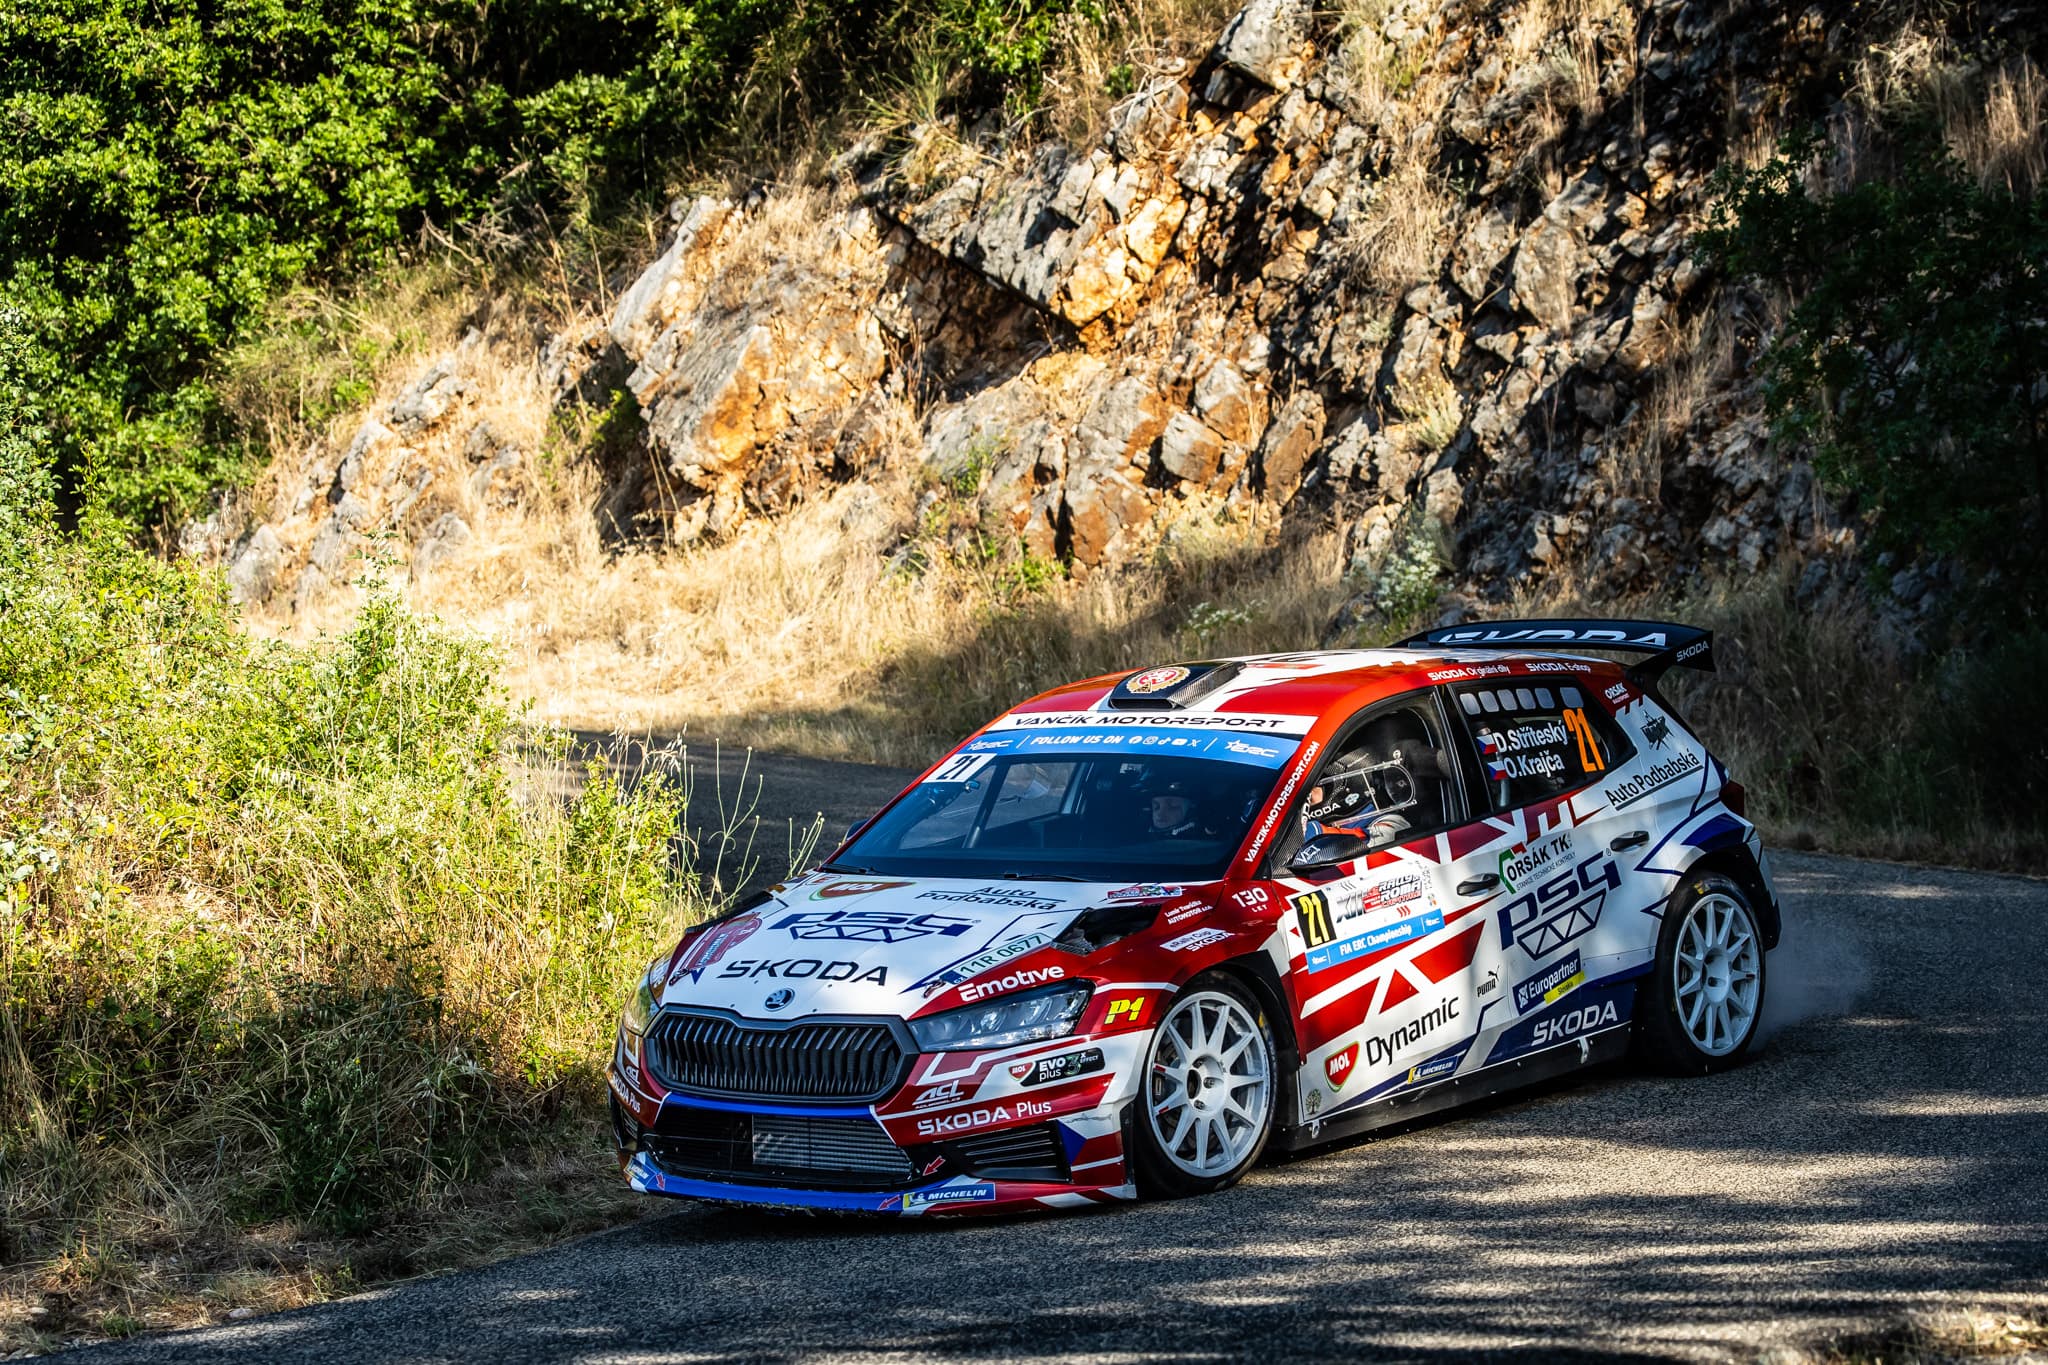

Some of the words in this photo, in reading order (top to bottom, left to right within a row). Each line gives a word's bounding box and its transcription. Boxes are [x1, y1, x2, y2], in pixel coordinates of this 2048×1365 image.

[1676, 640, 1710, 663] SKODA
[1015, 714, 1094, 726] VANČÍK
[1096, 716, 1286, 728] MOTORSPORT
[1030, 735, 1081, 745] FOLLOW
[1082, 735, 1103, 744] US
[1103, 735, 1124, 744] ON
[1563, 707, 1606, 773] 21
[935, 755, 982, 780] 21
[1503, 749, 1566, 779] O.Krajča
[1604, 777, 1638, 806] Auto
[1636, 748, 1700, 793] Podbabská
[1244, 740, 1321, 864] VANCIK-MOTORSPORT.COM
[1507, 844, 1551, 882] ORSÁK
[972, 886, 1038, 897] Auto
[1231, 887, 1270, 908] 130
[1252, 904, 1269, 913] LET
[1298, 894, 1331, 947] 21
[959, 956, 999, 974] 11R
[999, 934, 1043, 960] 0677
[1339, 943, 1353, 956] FIA
[716, 959, 889, 987] SKODA
[958, 965, 1065, 1002] Emotive
[1528, 958, 1578, 999] Europartner
[1477, 978, 1497, 997] PUMA
[1104, 996, 1145, 1025] P1
[1531, 1000, 1618, 1047] SKODA
[1365, 995, 1460, 1067] Dynamic
[1040, 1057, 1066, 1072] EVO
[1040, 1068, 1062, 1081] plus
[1329, 1050, 1351, 1077] MOL
[917, 1106, 1011, 1136] SKODA
[1016, 1101, 1052, 1118] Plus
[928, 1189, 987, 1200] MICHELIN
